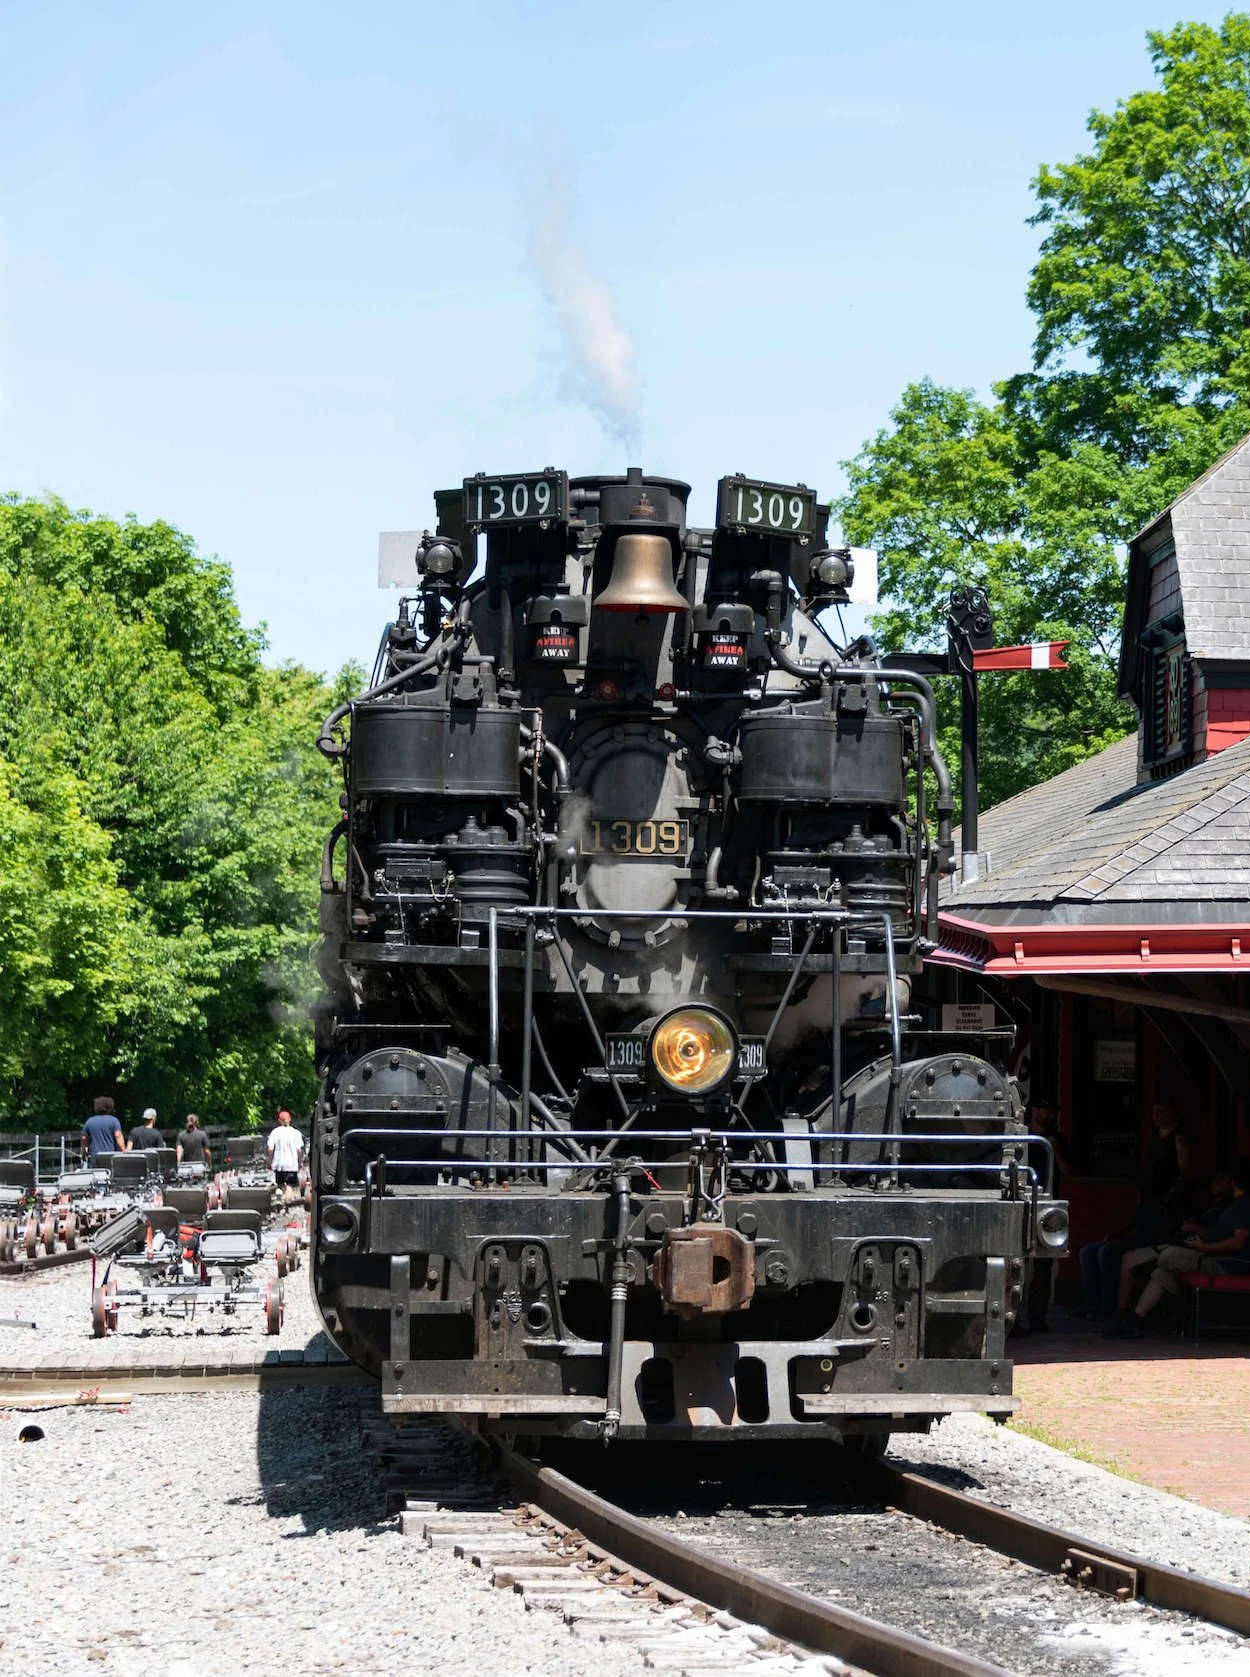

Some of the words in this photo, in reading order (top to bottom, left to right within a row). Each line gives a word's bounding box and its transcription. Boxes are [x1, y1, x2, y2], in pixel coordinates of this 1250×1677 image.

[478, 482, 550, 520] 1309
[737, 487, 803, 529] 1309
[712, 634, 738, 643] KEEP
[541, 648, 570, 657] AWAY
[710, 656, 739, 665] AWAY
[591, 820, 679, 854] 1309
[609, 1041, 642, 1065] 1309
